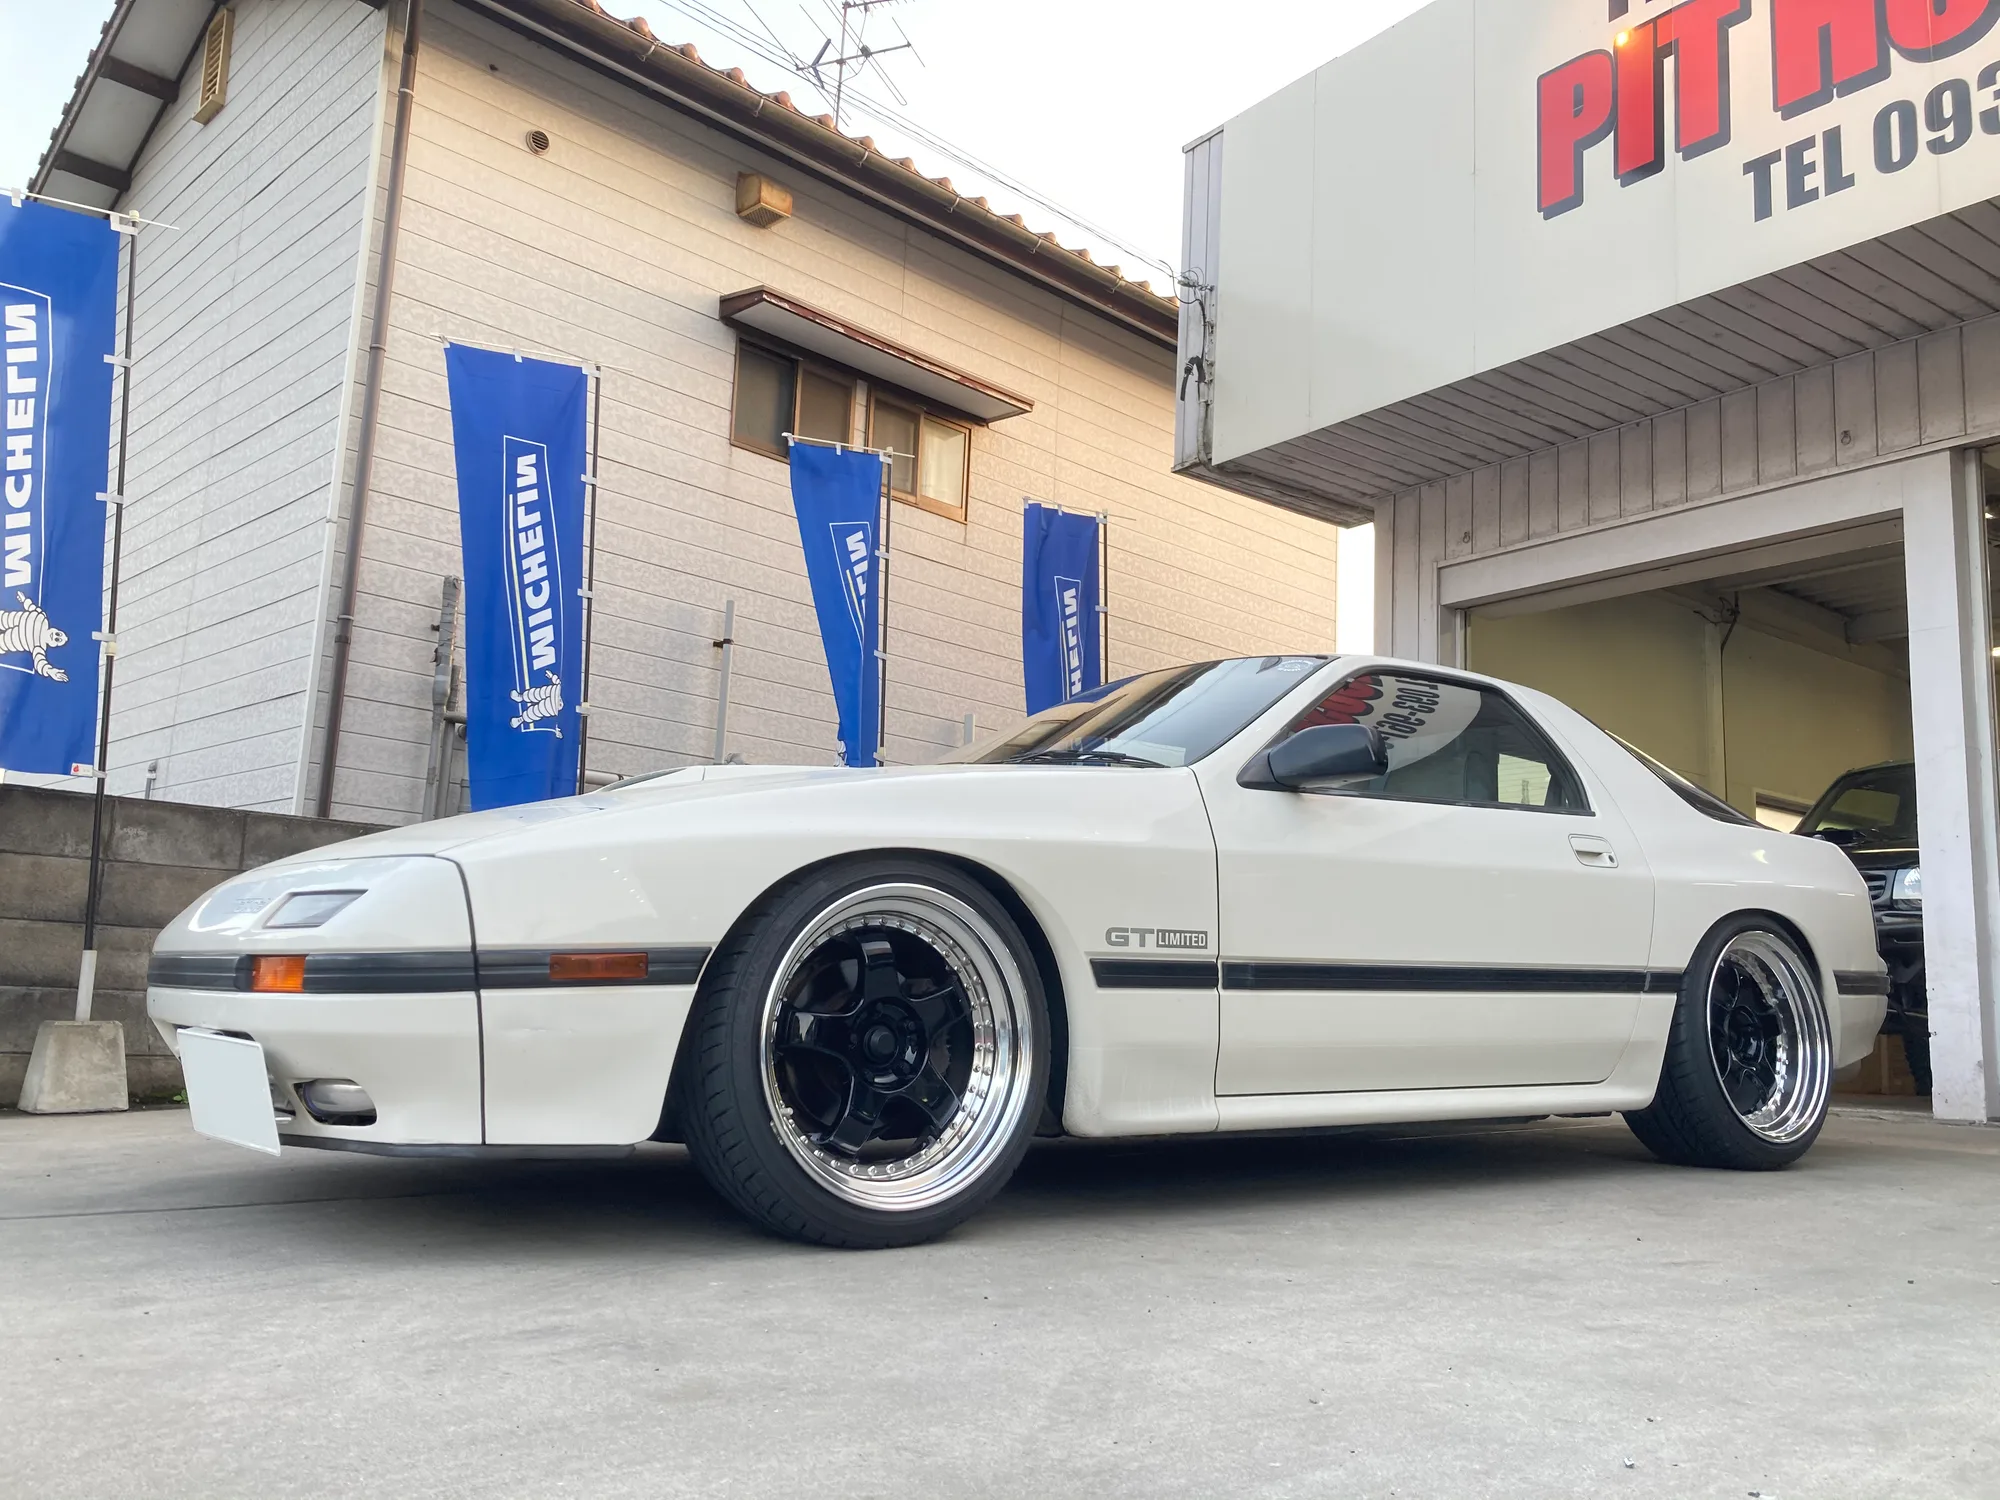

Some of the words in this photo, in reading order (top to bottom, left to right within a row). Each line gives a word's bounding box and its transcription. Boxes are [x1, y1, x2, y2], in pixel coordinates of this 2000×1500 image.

[1537, 0, 1752, 220] PIT
[1742, 125, 1855, 223] TEL
[1105, 926, 1155, 947] GT
[1158, 931, 1206, 946] LIMITED
